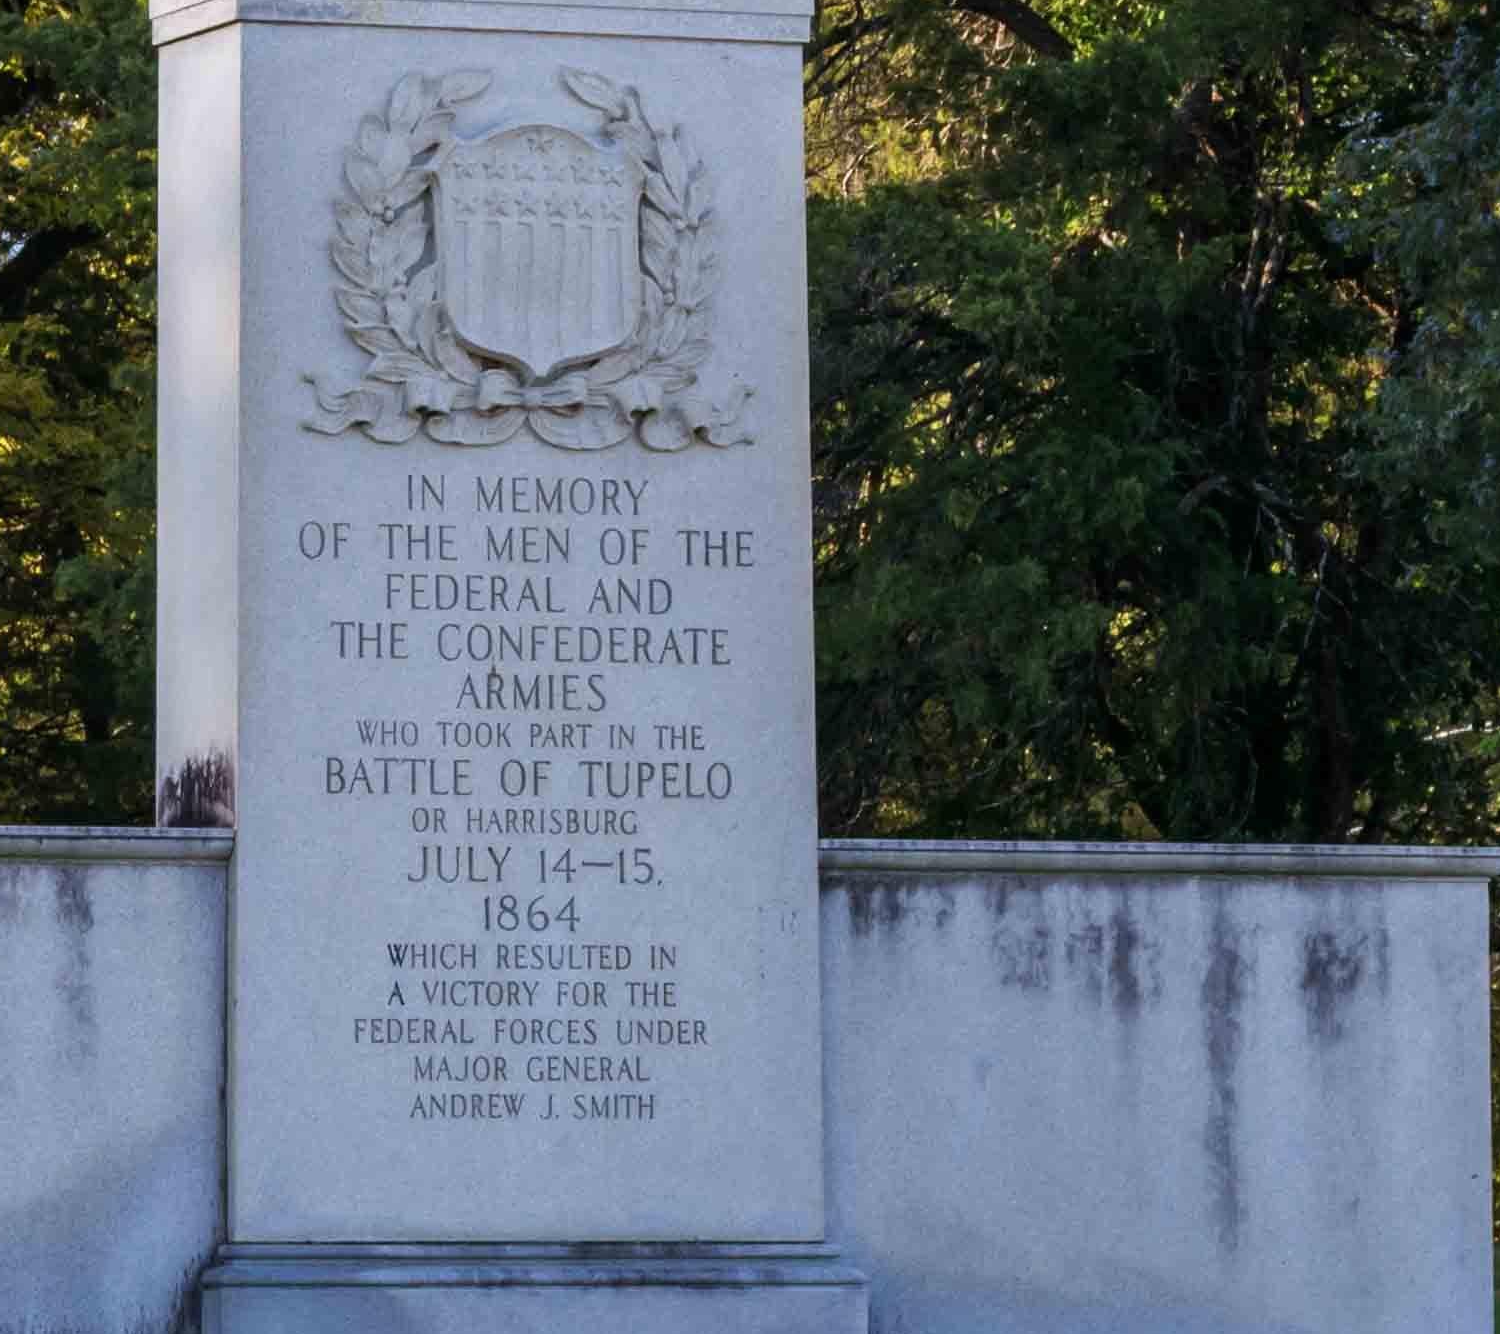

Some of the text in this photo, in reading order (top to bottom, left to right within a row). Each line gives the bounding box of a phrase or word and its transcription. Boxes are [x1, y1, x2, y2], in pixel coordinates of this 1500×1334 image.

[407, 474, 649, 517] IN MEMORY
[298, 520, 755, 569] OF THE MEN OF THE
[385, 572, 673, 616] FEDERAL AND
[329, 620, 732, 667] THE CONFEDERATE
[455, 672, 608, 713] ARMIES
[355, 719, 706, 752] WHO TOOK PART IN THE
[325, 756, 733, 801] BATTLE OF TUPELO
[411, 806, 638, 836] OR HARRISBURG
[407, 844, 512, 884] JULY
[483, 893, 581, 934] 1864
[386, 942, 677, 971] WHICH RESULTED IN
[387, 980, 677, 1008] A VICTORY FOR THE
[353, 1017, 708, 1046] FEDERAL FORCES UNDER
[413, 1055, 651, 1083] MAJOR GENERAL
[409, 1092, 656, 1121] ANDREW J. SMITH
